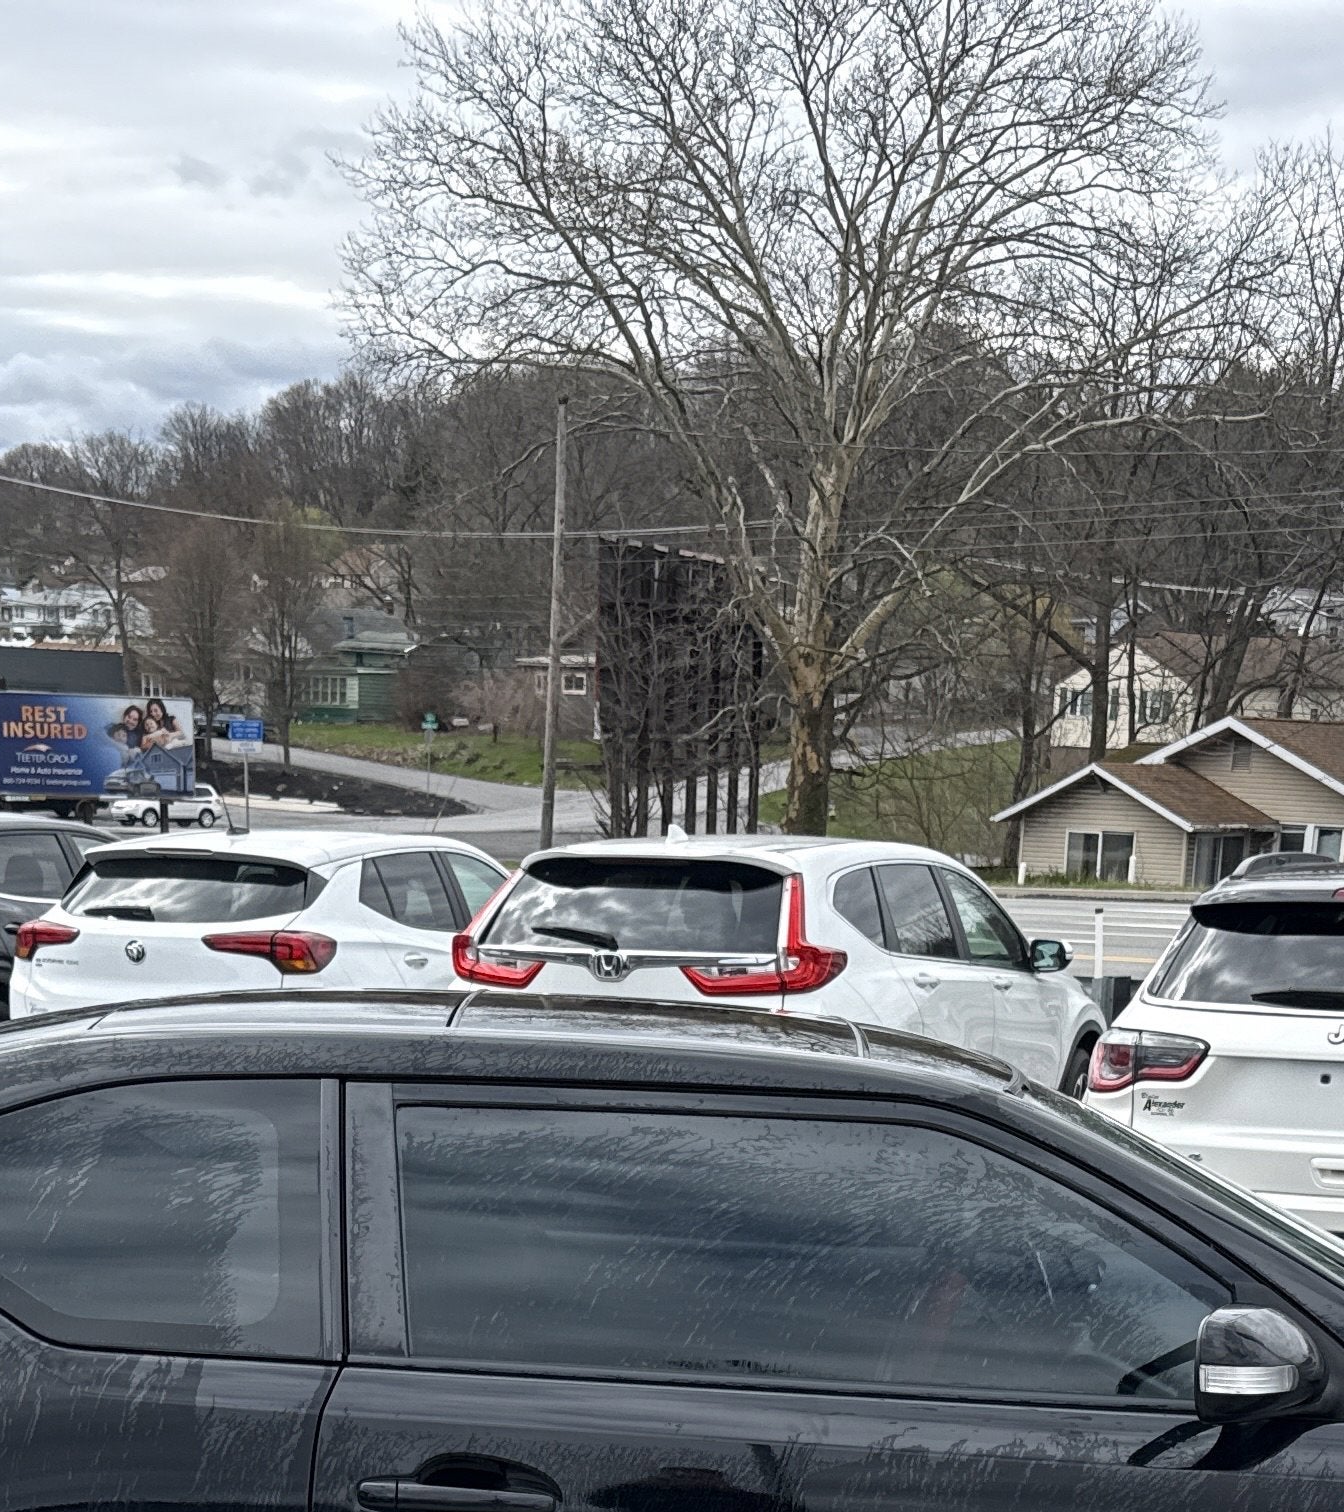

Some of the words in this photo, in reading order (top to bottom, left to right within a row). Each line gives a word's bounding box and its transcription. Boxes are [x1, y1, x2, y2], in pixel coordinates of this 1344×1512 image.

[21, 705, 68, 723] REST
[2, 721, 88, 740] INSURED
[16, 752, 46, 763] TEETER
[47, 753, 79, 764] GROUP
[10, 766, 30, 774] Home
[36, 767, 52, 775] Auto
[52, 767, 84, 776] Insurance
